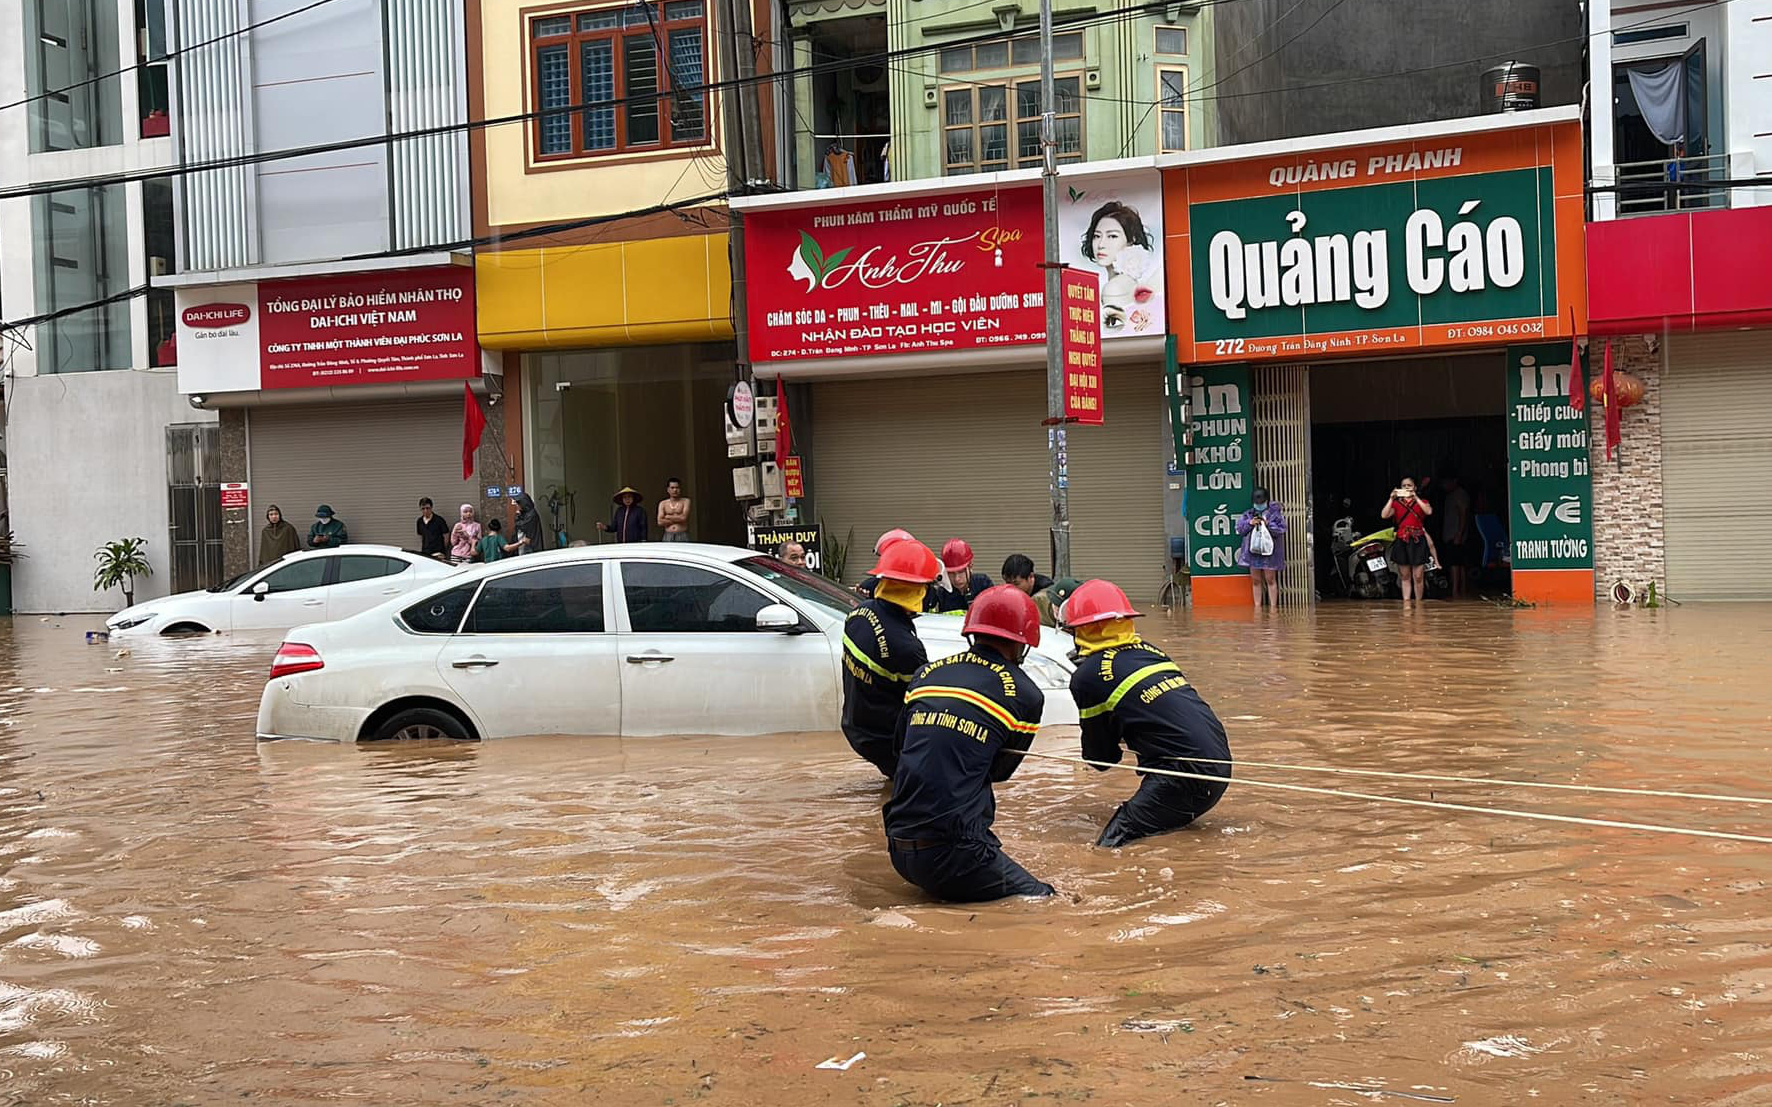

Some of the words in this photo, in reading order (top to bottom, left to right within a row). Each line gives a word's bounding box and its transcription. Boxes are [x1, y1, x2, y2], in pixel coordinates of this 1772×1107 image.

[814, 215, 845, 228] PHUN
[847, 211, 875, 226] XĂM
[878, 203, 913, 222] THẨM
[918, 202, 938, 219] MỸ
[943, 198, 976, 216] QUỐC
[982, 195, 996, 212] TẾ
[821, 245, 902, 290] Anh
[896, 231, 980, 284] Thu
[976, 226, 1022, 252] Spa
[1209, 210, 1389, 320] Quảng
[1405, 199, 1525, 294] Cáo
[267, 296, 299, 313] TỔNG
[301, 299, 322, 313] ĐẠI
[324, 294, 337, 309] LÝ
[340, 292, 364, 308] BẢO
[366, 288, 397, 306] HIỂM
[399, 288, 434, 304] NHÂN
[436, 288, 462, 303] THỌ
[767, 309, 793, 327] CHĂM
[795, 307, 812, 325] SÓC
[814, 309, 826, 324] DA
[837, 306, 860, 322] PHUN
[900, 302, 919, 317] NAIL
[930, 300, 942, 315] MI
[952, 296, 967, 316] GỘI
[969, 292, 987, 312] ĐẦU
[990, 292, 1019, 311] DƯỠNG
[1023, 292, 1044, 308] SINH
[186, 309, 223, 321] DAI-ICHI
[224, 308, 244, 319] LIFE
[310, 314, 358, 328] DAI-ICHI
[359, 310, 385, 327] VIỆT
[388, 310, 417, 323] NAM
[801, 328, 847, 344] NHẬN
[849, 325, 883, 340] ĐÀO
[886, 322, 917, 339] TẠO
[921, 321, 956, 336] HỌC
[961, 316, 1000, 331] VIÊN
[1467, 326, 1494, 337] 0984
[1497, 324, 1518, 335] 045
[1520, 322, 1542, 333] 032
[268, 343, 291, 353] CÔNG
[291, 343, 301, 352] TY
[303, 341, 324, 351] TNHH
[326, 338, 343, 351] MỘT
[345, 337, 373, 348] THÀNH
[374, 335, 392, 346] VIÊN
[394, 336, 408, 347] ĐẠI
[409, 333, 431, 344] PHÚC
[432, 333, 450, 342] SƠN
[451, 332, 463, 341] LA
[783, 349, 796, 357] 274
[888, 342, 896, 350] La
[911, 340, 925, 348] Anh
[940, 339, 954, 347] Spa
[1215, 338, 1245, 355] 272
[1393, 333, 1406, 343] La
[1520, 355, 1572, 397] in
[1192, 376, 1241, 416] in
[1192, 419, 1246, 437] PHUN
[1519, 428, 1552, 452] Giấy
[1557, 429, 1586, 449] mời
[1195, 438, 1242, 464] KHỔ
[1196, 469, 1242, 490] LỚN
[1521, 460, 1569, 478] Phong
[1573, 458, 1588, 476] bì
[757, 530, 793, 545] THÀNH
[796, 531, 817, 543] DUY
[1516, 540, 1548, 559] TRANH
[1551, 534, 1588, 558] TƯỜNG
[805, 549, 820, 573] ỘI
[999, 671, 1016, 697] CNCH
[925, 711, 938, 725] AN
[957, 717, 978, 737] SƠN
[976, 726, 988, 744] LA
